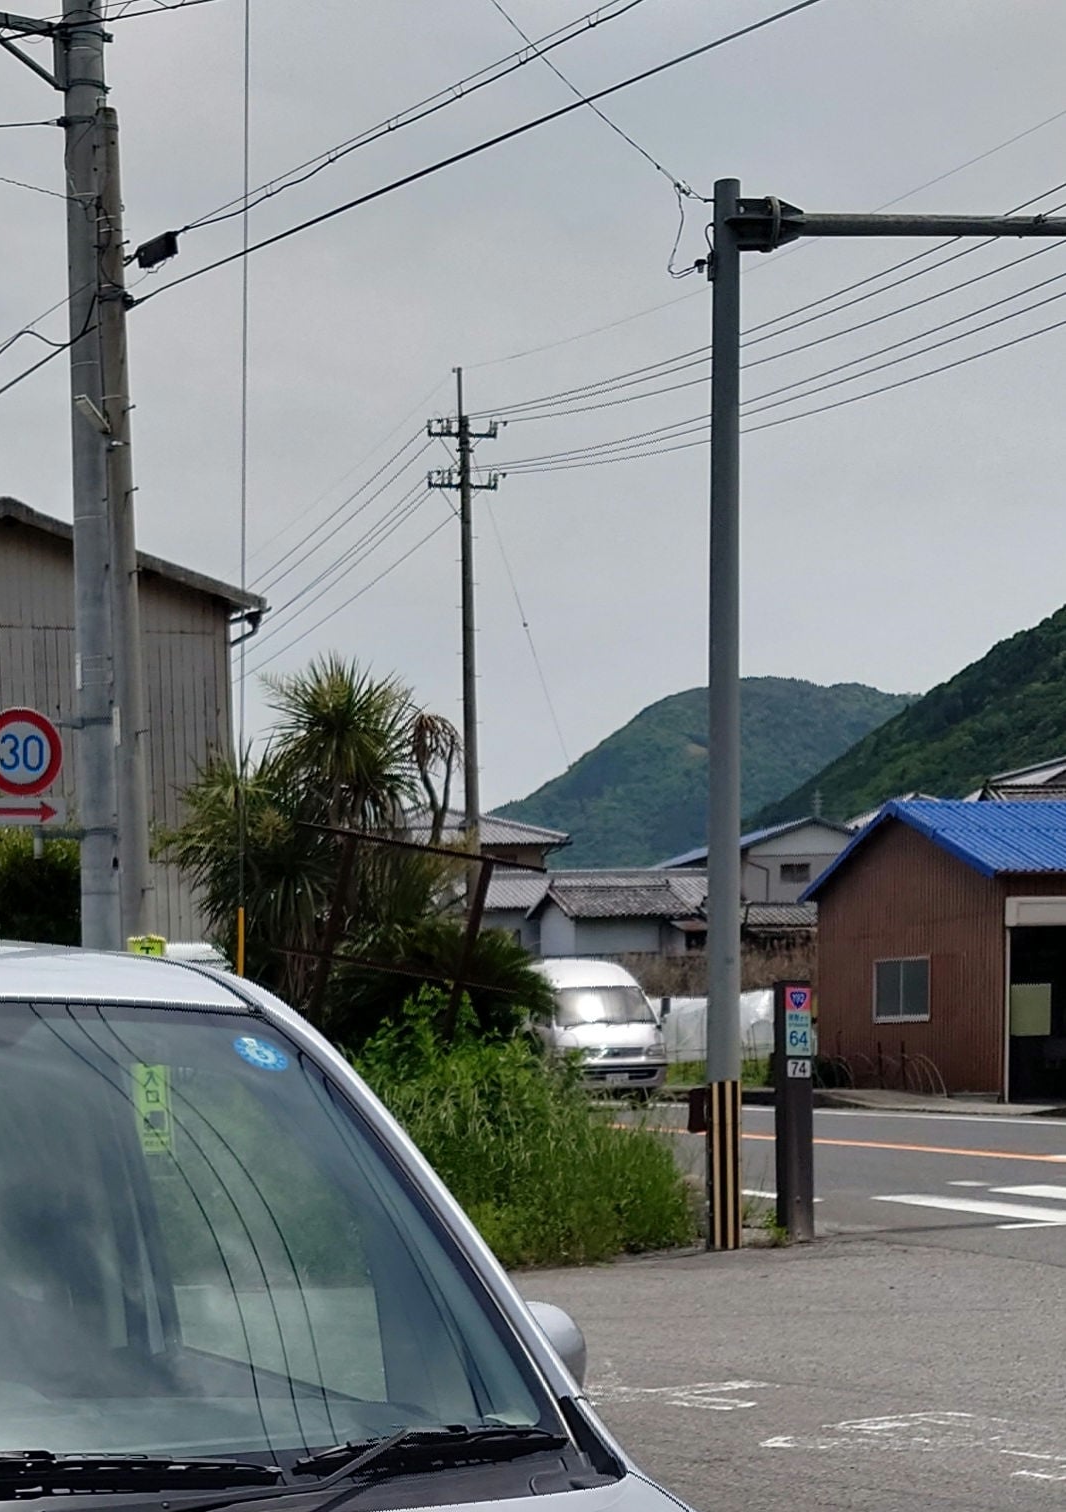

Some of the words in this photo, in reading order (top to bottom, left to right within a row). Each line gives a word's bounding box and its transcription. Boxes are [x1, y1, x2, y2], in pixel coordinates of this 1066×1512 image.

[0, 733, 45, 772] 30
[789, 1030, 808, 1047] 64
[791, 1061, 807, 1076] 74
[142, 1069, 161, 1103] 入口
